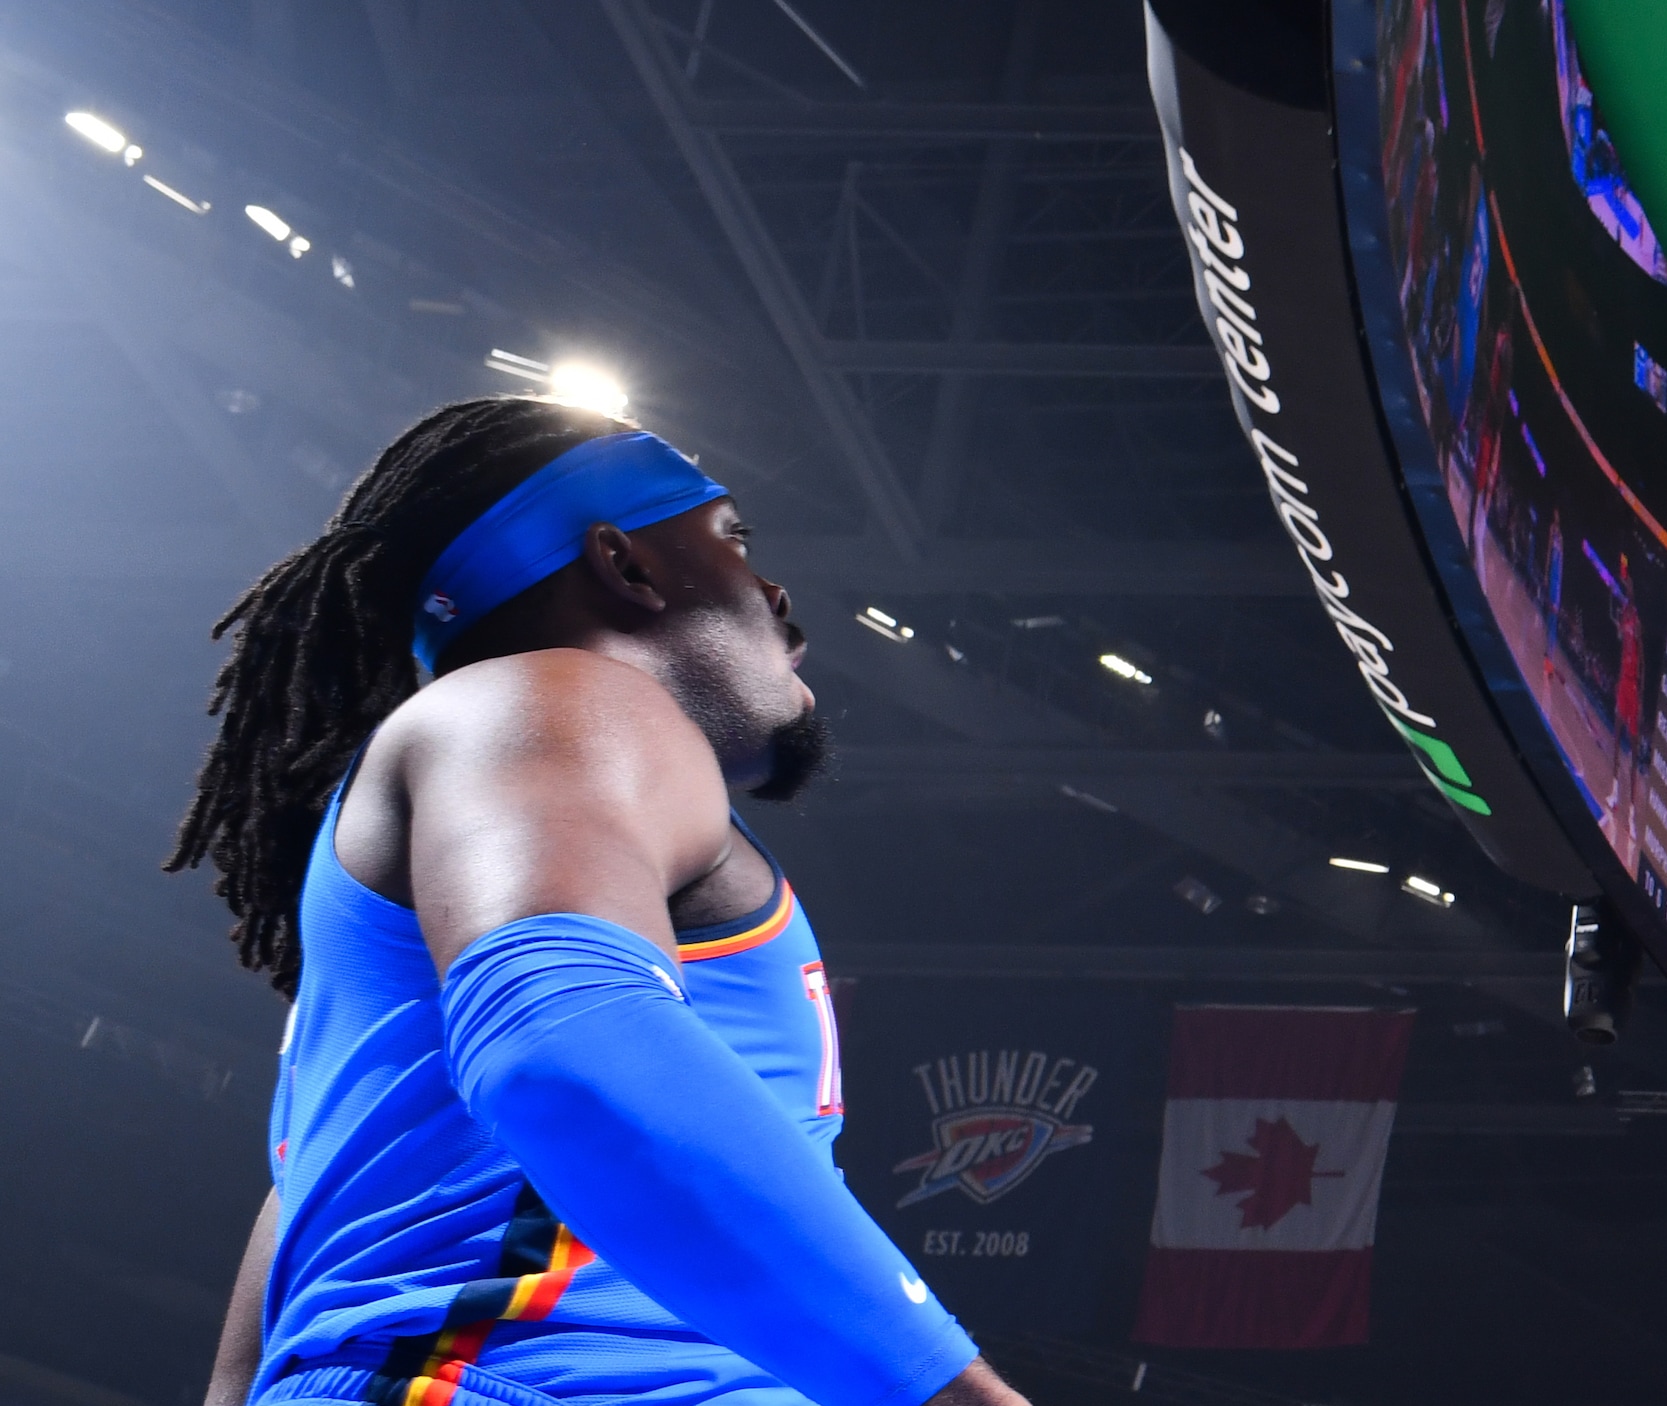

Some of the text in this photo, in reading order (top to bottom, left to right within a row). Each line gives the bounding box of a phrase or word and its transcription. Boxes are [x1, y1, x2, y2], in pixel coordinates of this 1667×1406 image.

[1179, 146, 1436, 728] paycom center
[912, 1049, 1099, 1118] THUNDER
[923, 1231, 1030, 1257] EST. 2008
